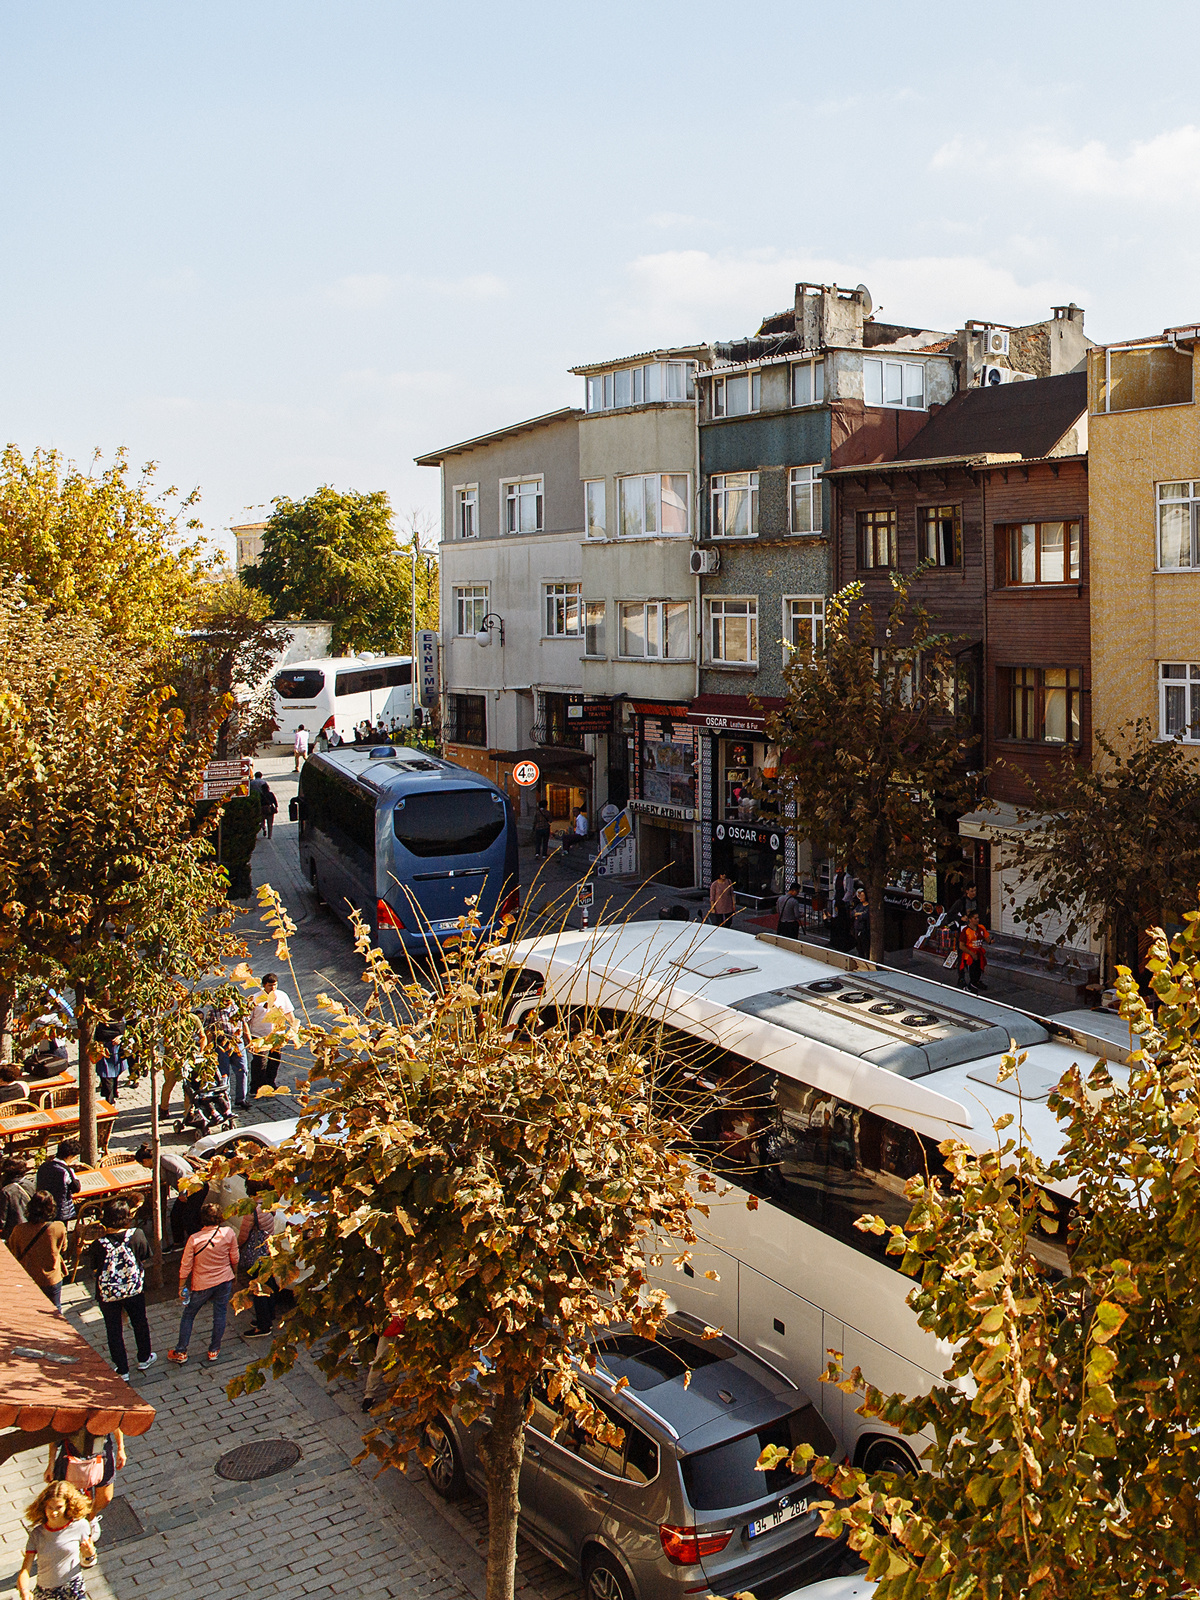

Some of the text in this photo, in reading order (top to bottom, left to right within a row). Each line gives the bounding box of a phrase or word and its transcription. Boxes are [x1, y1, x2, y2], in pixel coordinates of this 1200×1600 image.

[705, 717, 727, 727] OSCAR
[629, 802, 659, 815] GALLERY
[728, 826, 757, 842] OSCAR
[580, 897, 592, 905] VIP
[755, 1518, 767, 1533] 34
[790, 1499, 806, 1517] 282
